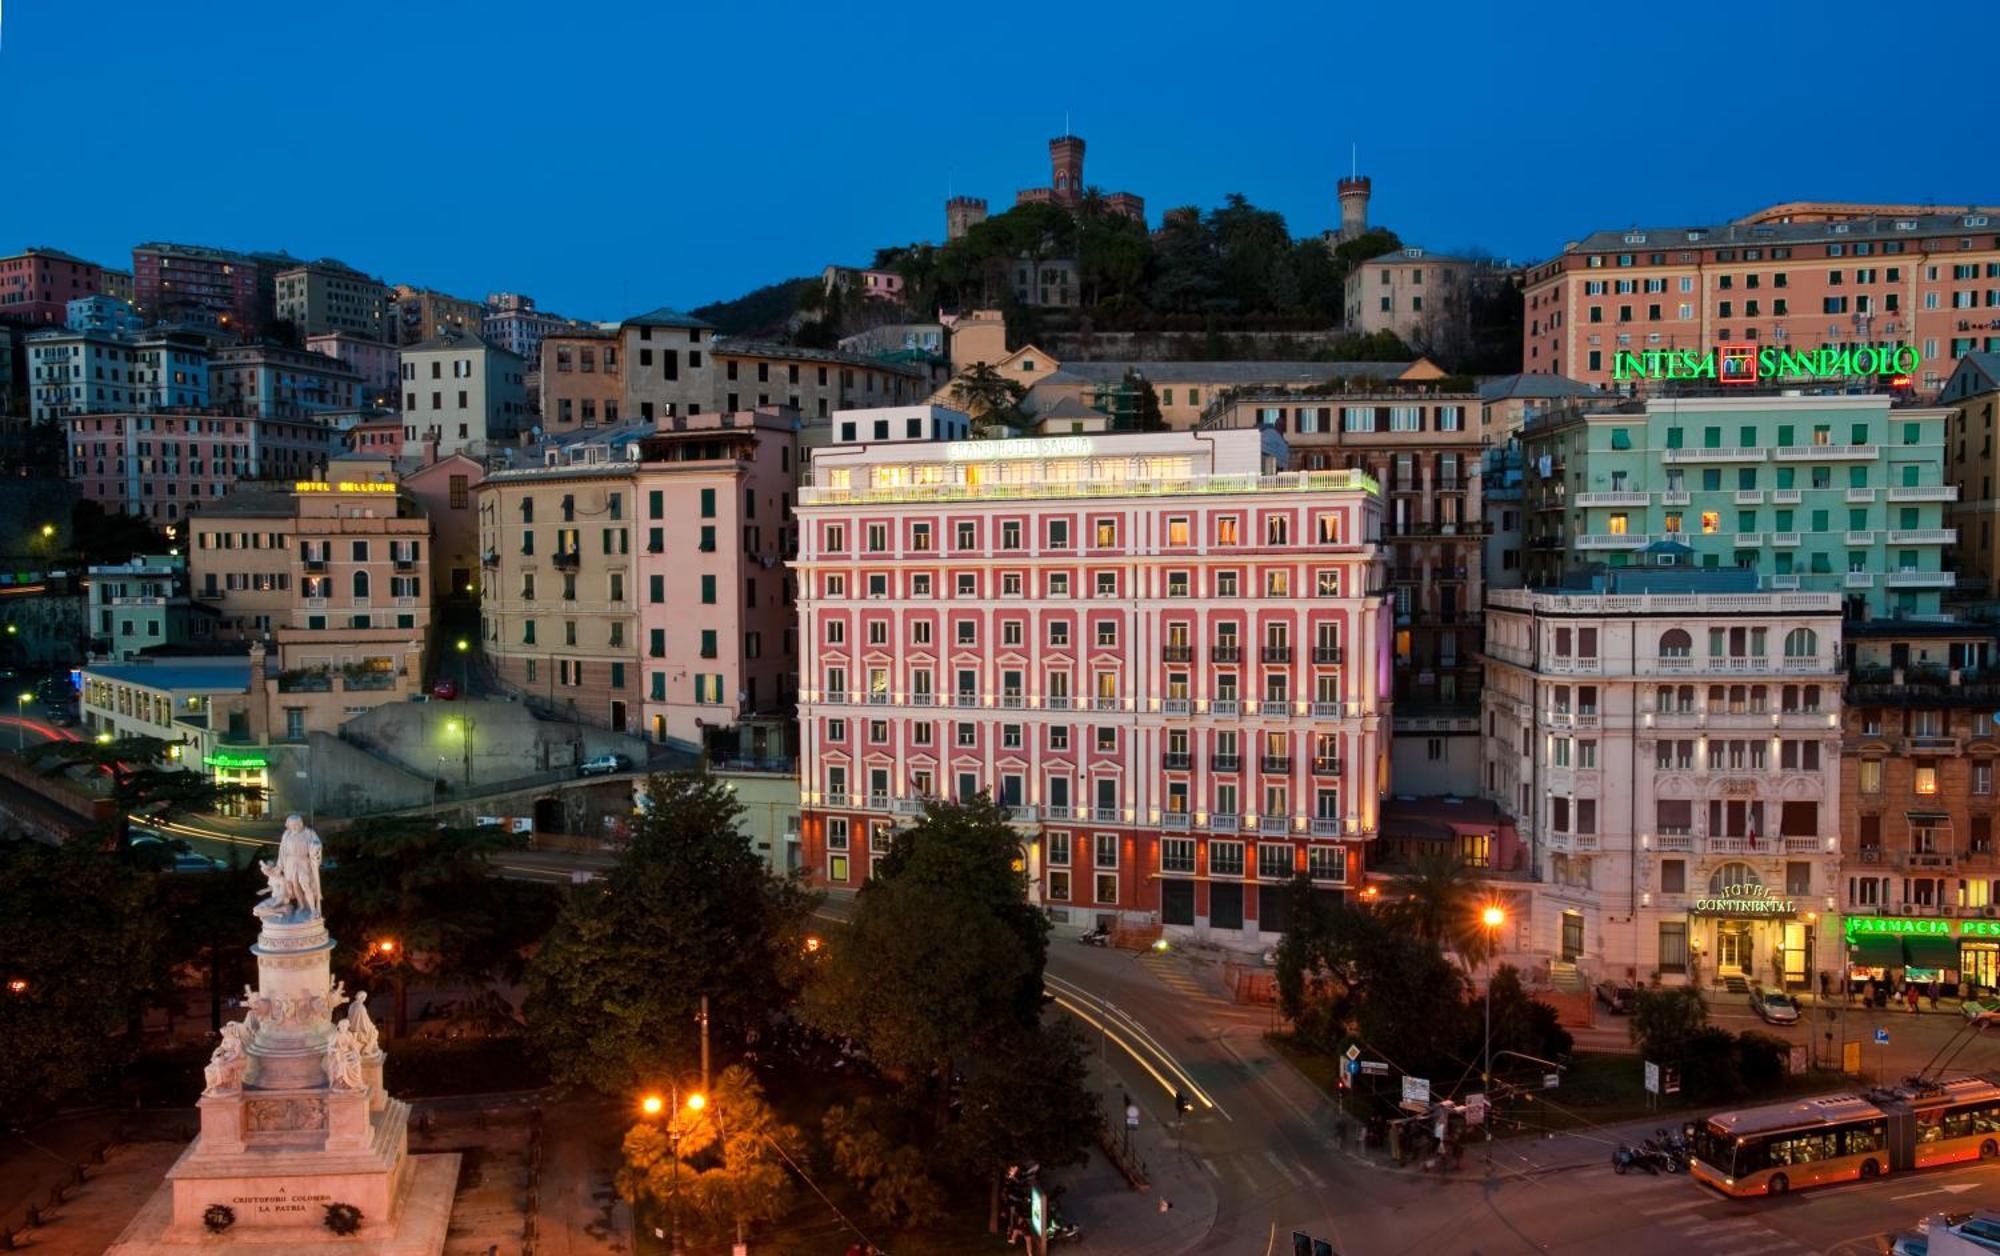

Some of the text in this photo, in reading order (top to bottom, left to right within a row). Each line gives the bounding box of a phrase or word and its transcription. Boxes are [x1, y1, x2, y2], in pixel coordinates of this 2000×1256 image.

[1613, 345, 1919, 379] INTESA SANPAOLO
[998, 439, 1039, 457] HOTEL
[1042, 437, 1090, 455] SAVOIA
[296, 482, 396, 491] HOTEL BELLEVUE
[1721, 883, 1771, 899] HOTEL
[1696, 899, 1796, 912] CONTINENTAL
[1853, 919, 1949, 933] FARMACIA
